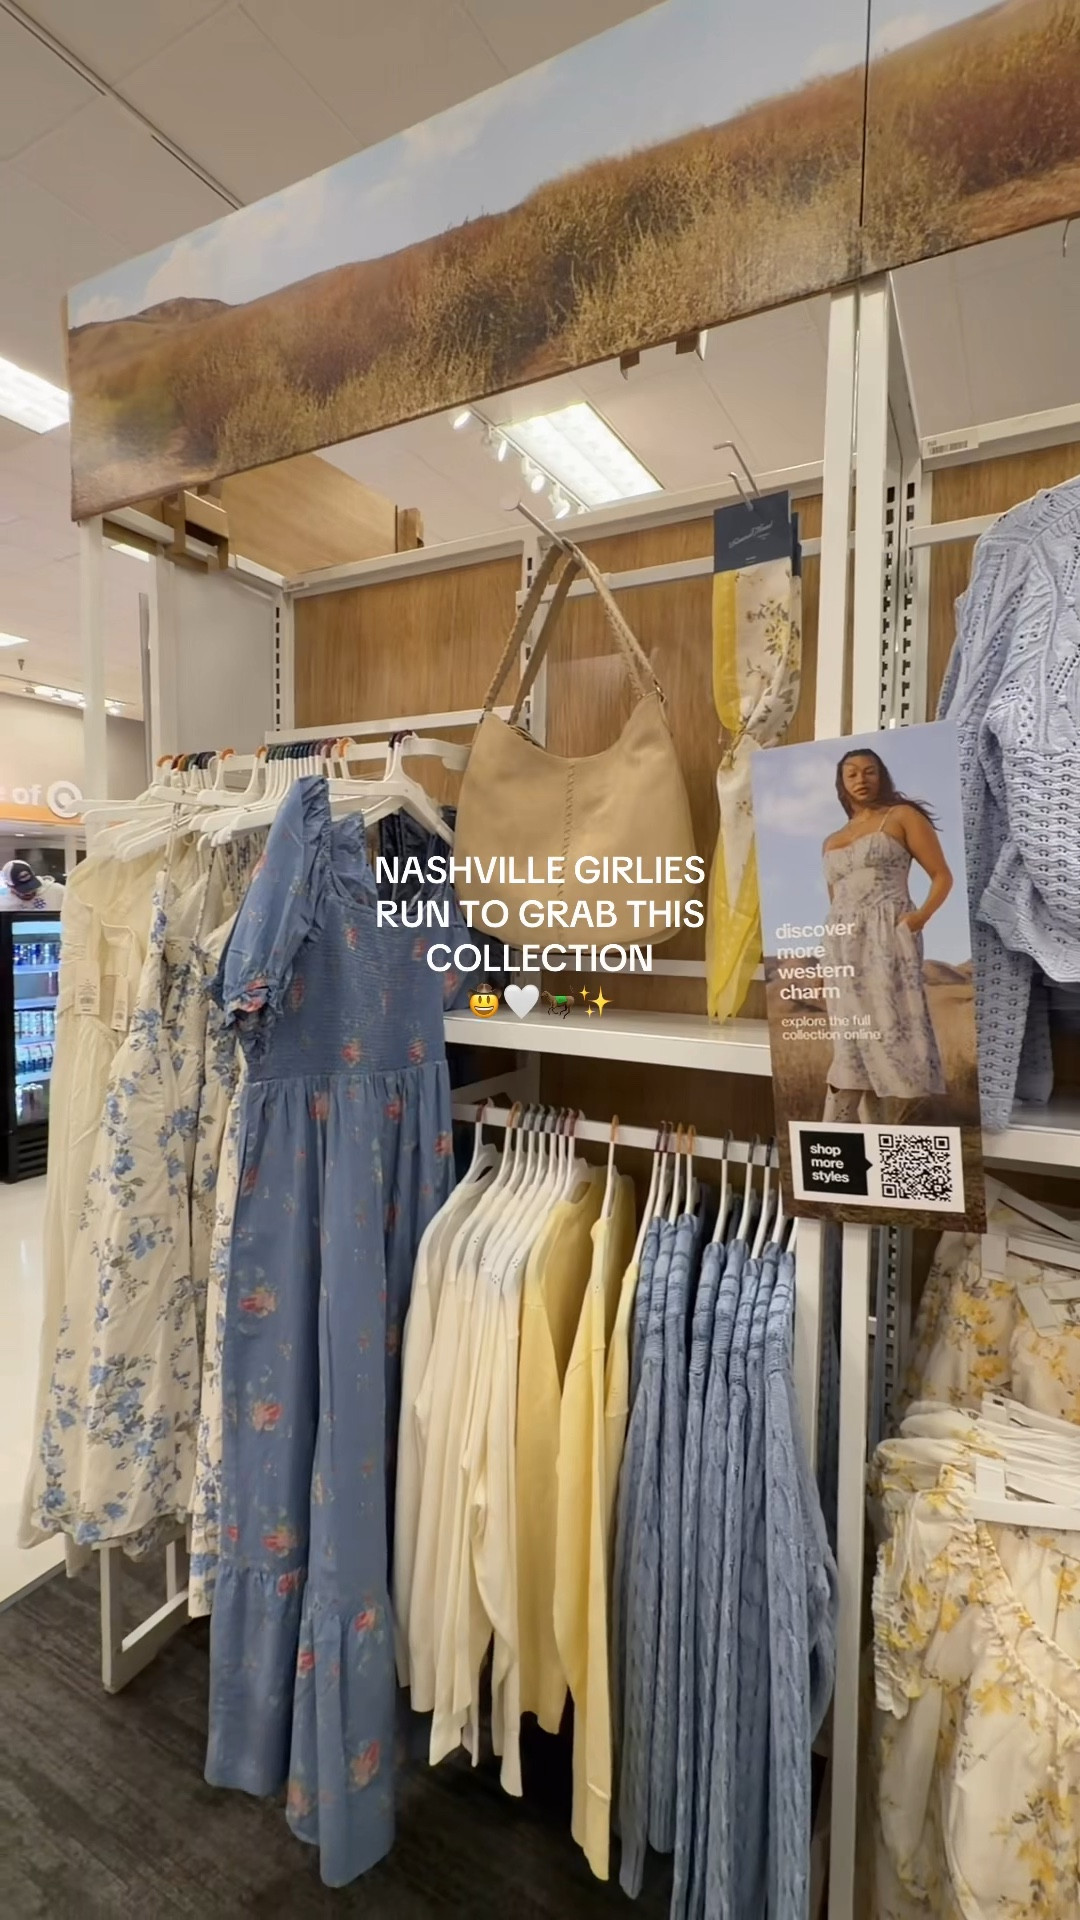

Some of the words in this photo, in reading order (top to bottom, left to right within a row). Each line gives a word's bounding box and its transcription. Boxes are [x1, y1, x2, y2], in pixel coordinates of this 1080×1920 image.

[12, 784, 42, 806] of
[775, 922, 856, 940] discover
[777, 945, 826, 960] more
[778, 963, 855, 980] western
[780, 984, 841, 1001] charm
[781, 1016, 827, 1028] explore
[829, 1015, 850, 1027] the
[853, 1014, 872, 1027] full
[782, 1029, 840, 1041] collection
[844, 1029, 881, 1041] online
[810, 1143, 842, 1157] shop
[811, 1158, 844, 1169] more
[812, 1170, 850, 1184] styles
